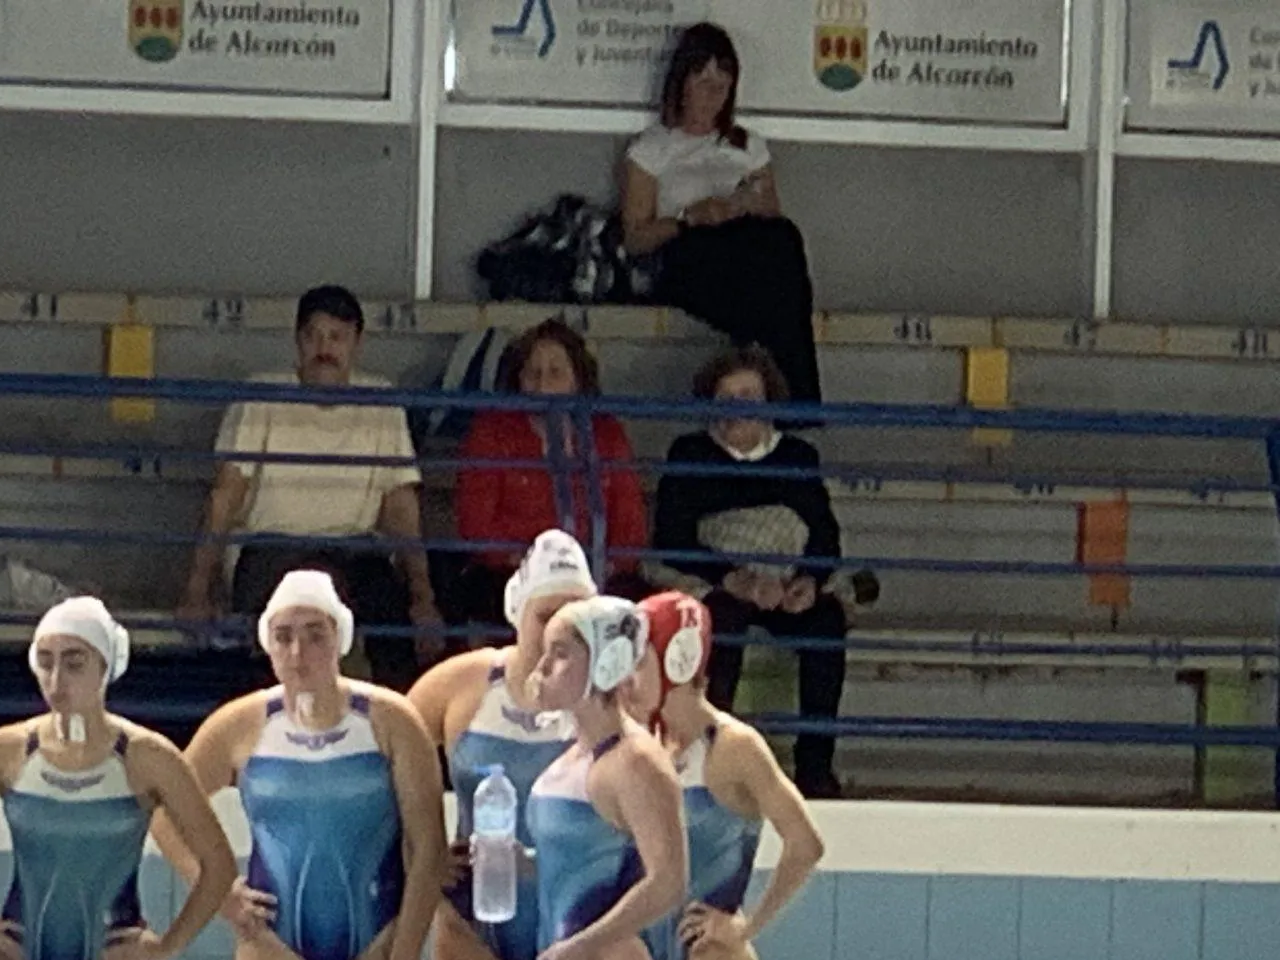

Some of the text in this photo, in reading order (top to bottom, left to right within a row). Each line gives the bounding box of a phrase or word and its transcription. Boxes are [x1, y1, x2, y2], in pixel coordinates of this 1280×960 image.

[188, 0, 360, 28] Ayuntamiento
[187, 28, 337, 58] de Alcorcón
[873, 29, 1038, 57] Ayuntamiento
[871, 59, 1015, 88] de Alcorcón
